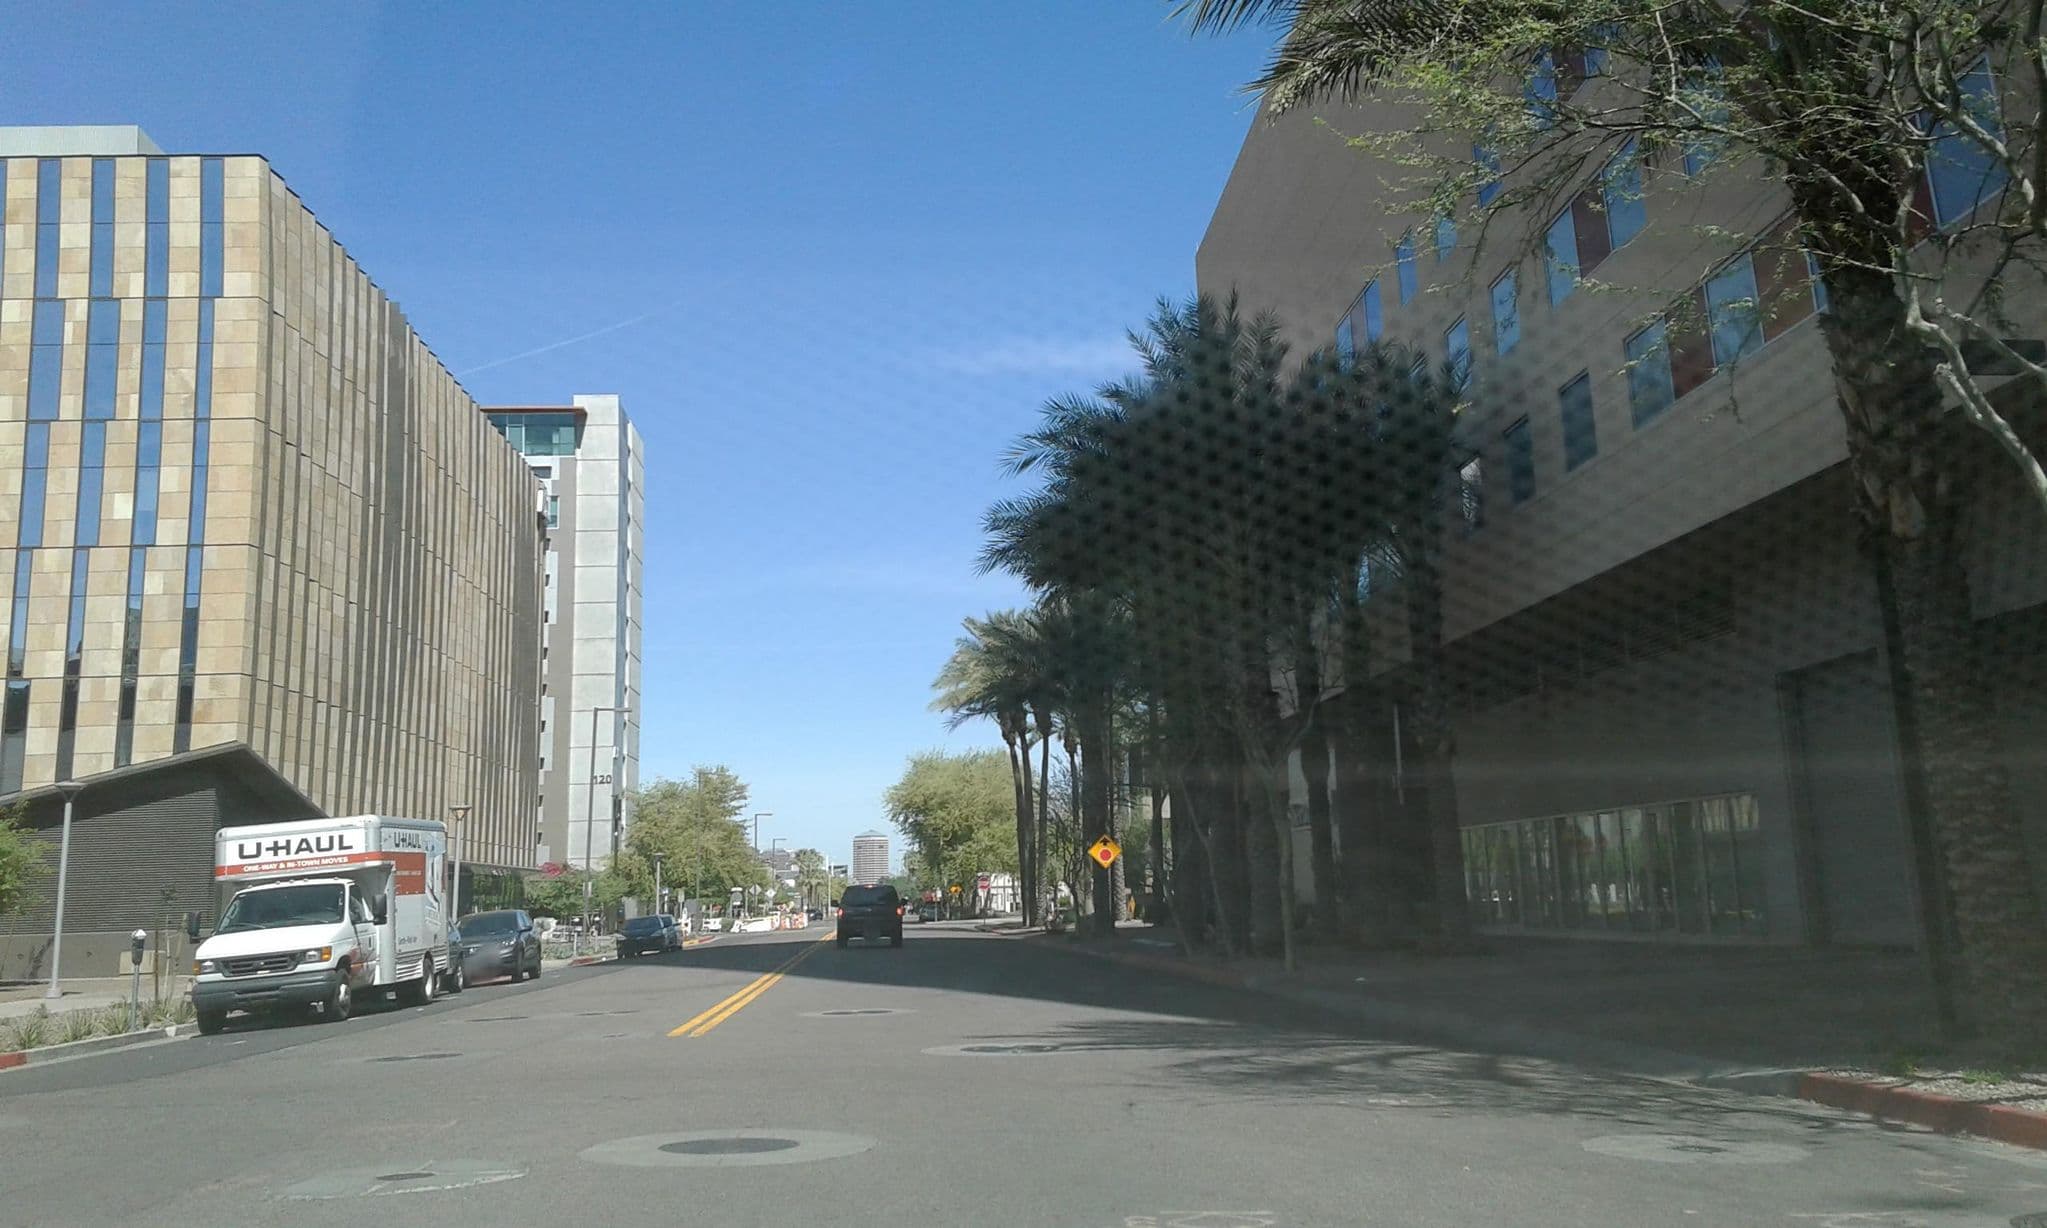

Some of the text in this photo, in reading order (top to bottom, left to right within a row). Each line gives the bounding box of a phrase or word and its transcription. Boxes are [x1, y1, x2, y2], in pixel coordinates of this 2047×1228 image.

[593, 774, 612, 785] 120
[238, 834, 353, 860] U-HAUL
[243, 863, 278, 873] ONE-WAY
[320, 856, 349, 865] MOVES
